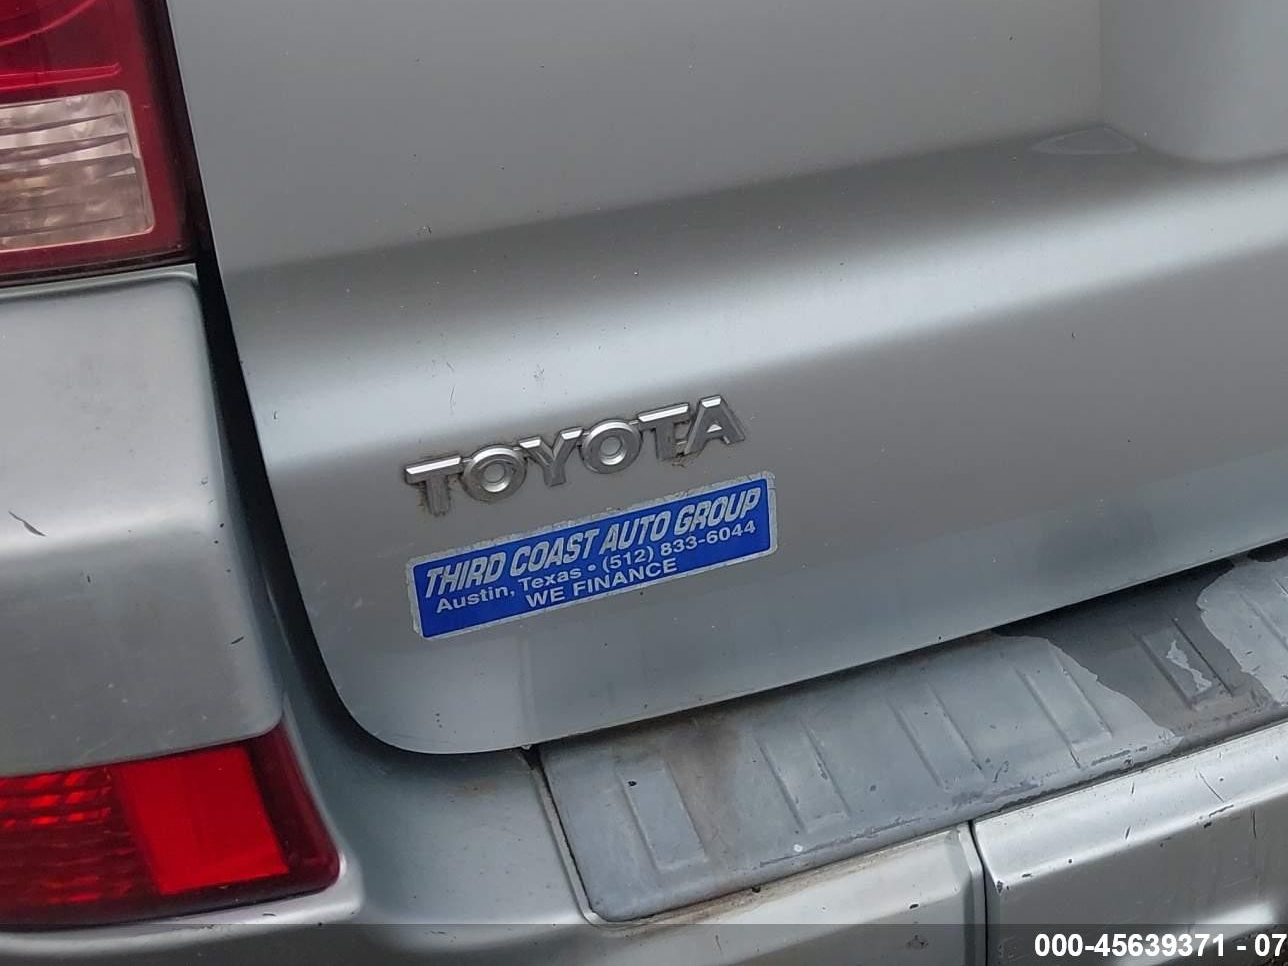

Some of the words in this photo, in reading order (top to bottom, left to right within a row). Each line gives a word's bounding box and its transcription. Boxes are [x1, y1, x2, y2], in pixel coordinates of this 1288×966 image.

[404, 394, 746, 516] TOYOTA
[425, 552, 506, 598] THIRD
[510, 529, 600, 576] COAST
[599, 510, 672, 555] AUTO
[674, 487, 762, 534] GROUP
[436, 584, 516, 614] Austin,
[518, 566, 582, 593] Texas
[602, 545, 655, 575] (512)
[660, 520, 756, 557] 833-6044
[525, 588, 566, 609] WE
[572, 557, 679, 597] FINANCE
